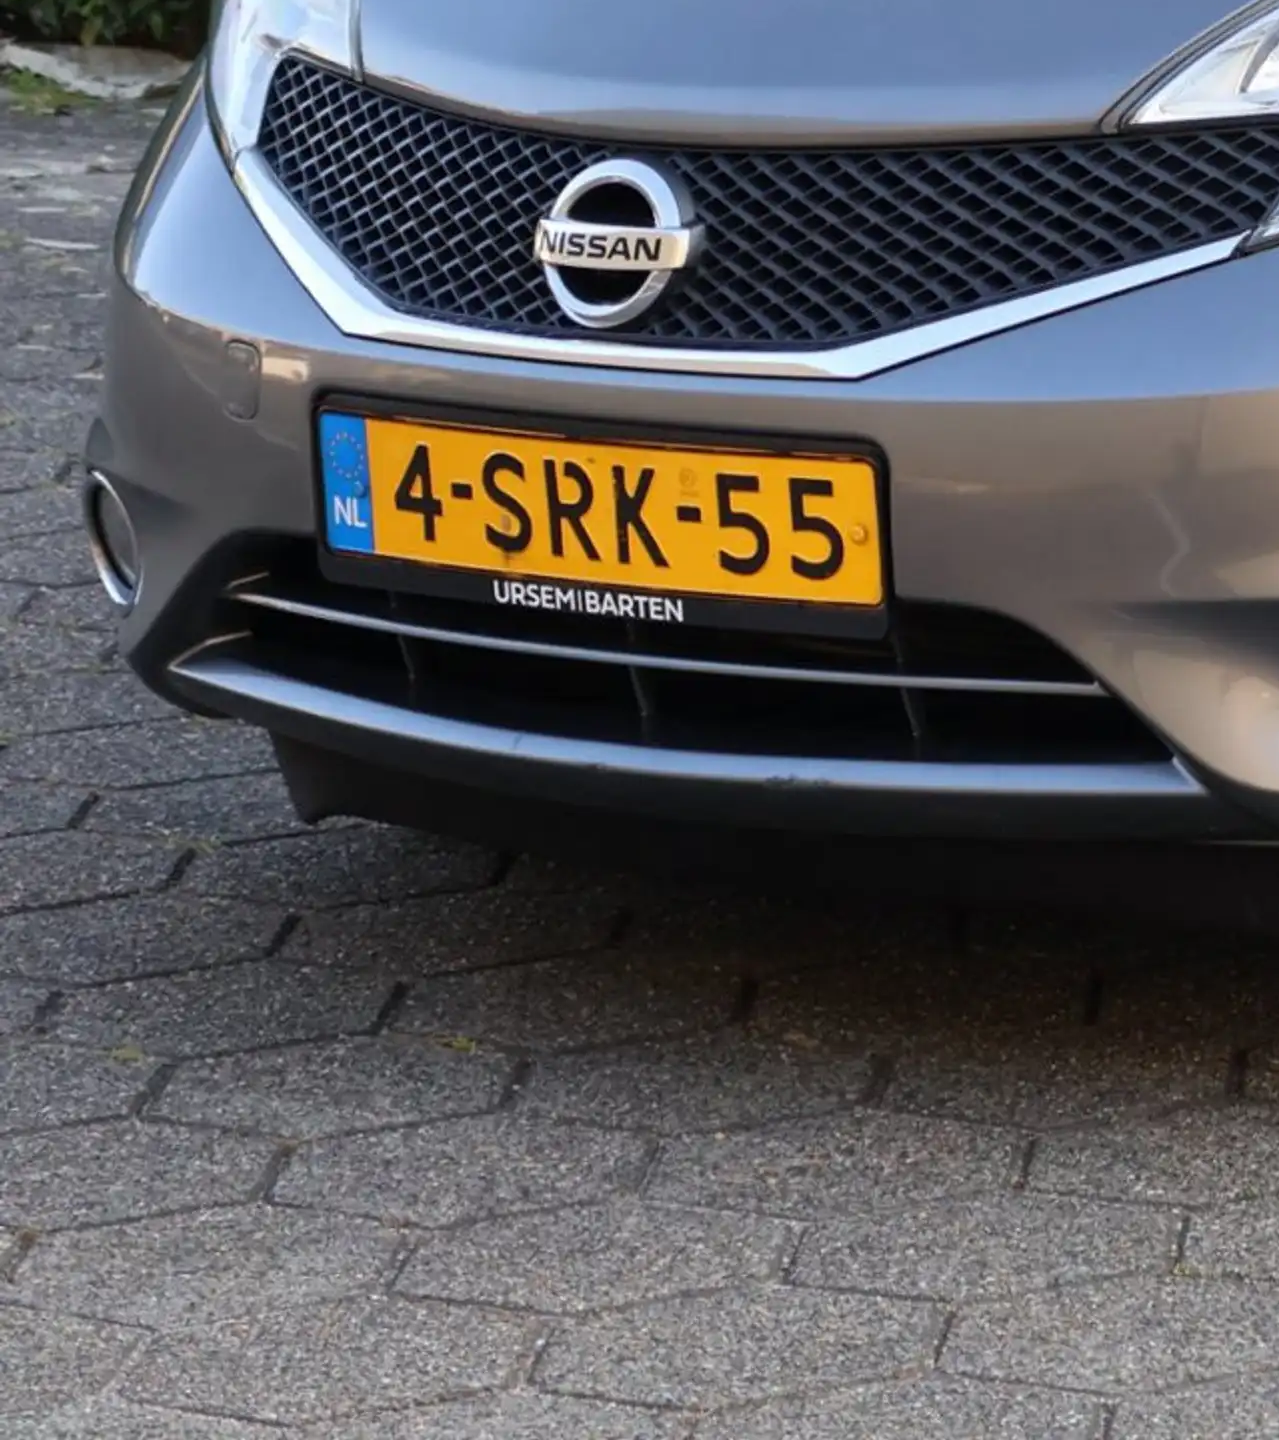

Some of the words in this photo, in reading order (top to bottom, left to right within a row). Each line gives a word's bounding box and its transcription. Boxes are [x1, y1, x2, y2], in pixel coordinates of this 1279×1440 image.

[538, 230, 662, 262] NISSAN
[333, 496, 368, 529] NL
[393, 442, 846, 581] 4-SRK-55
